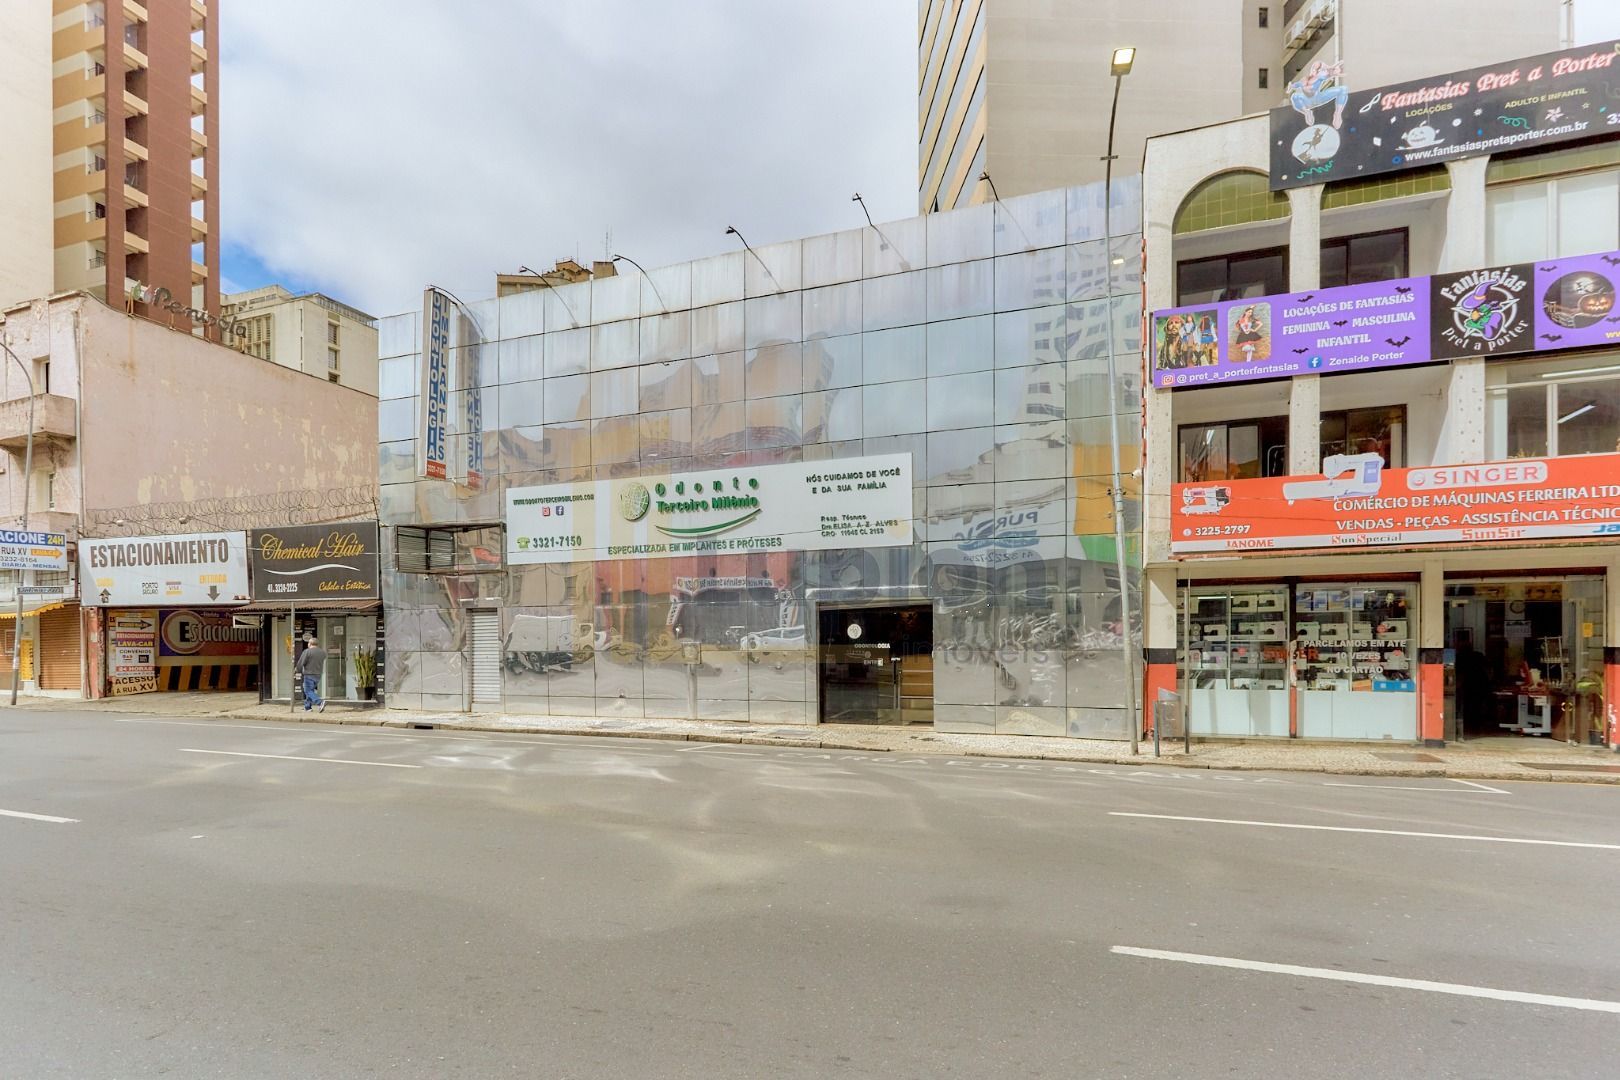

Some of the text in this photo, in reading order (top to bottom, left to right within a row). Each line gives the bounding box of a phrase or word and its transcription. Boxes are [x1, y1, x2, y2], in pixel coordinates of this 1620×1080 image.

[1380, 51, 1618, 111] Fantasias Pret a Porter
[1505, 88, 1588, 109] ADULTO E INFANTIL
[1405, 102, 1453, 118] LOCAÇÕES
[1405, 120, 1588, 161] www.fantasiaspretaporter.com.br
[1440, 267, 1527, 302] Fantasias
[1283, 294, 1415, 319] LOCAÇÕES DE FANTASIAS
[1282, 311, 1416, 336] FEMININA MASCULINA
[1317, 333, 1372, 349] INFANTIL
[1329, 350, 1405, 367] Zenaide Porter
[427, 291, 441, 460] ODONTOLOGIA
[438, 297, 449, 461] IMPLANTES
[806, 466, 901, 483] NÓS CUIDAMOS DE VOCÊ
[1433, 466, 1539, 485] SINGER
[655, 477, 759, 497] Odonto
[821, 485, 832, 493] DA
[837, 484, 852, 492] SUA
[857, 481, 887, 490] FAMÍLIA
[656, 499, 709, 514] Terceiro
[1333, 496, 1409, 511] COMÉRCIO
[1411, 495, 1430, 507] DE
[1433, 491, 1515, 507] MÁQUINAS
[1518, 486, 1588, 501] FERREIRA
[875, 519, 898, 527] ALVES
[1336, 518, 1394, 530] VENDAS
[1405, 515, 1450, 529] PEÇAS
[1460, 509, 1559, 525] ASSISTÊNCIA
[1195, 526, 1250, 535] 3225-2797
[47, 535, 64, 545] 24H
[260, 531, 364, 560] Chemical Hair
[532, 535, 582, 548] 3321-7150
[608, 545, 666, 555] ESPECIALIZADA
[682, 541, 727, 551] IMPLANTES
[729, 540, 735, 548] E
[737, 536, 782, 549] PRÓTESES
[1227, 539, 1274, 548] JANOME
[1, 547, 16, 555] RUA
[90, 539, 229, 567] ESTACIONAMENTO
[1304, 640, 1368, 648] PARCELAMOS
[1335, 652, 1381, 660] 10 VEZES
[115, 676, 154, 685] ACESSO
[140, 683, 154, 691] XV
